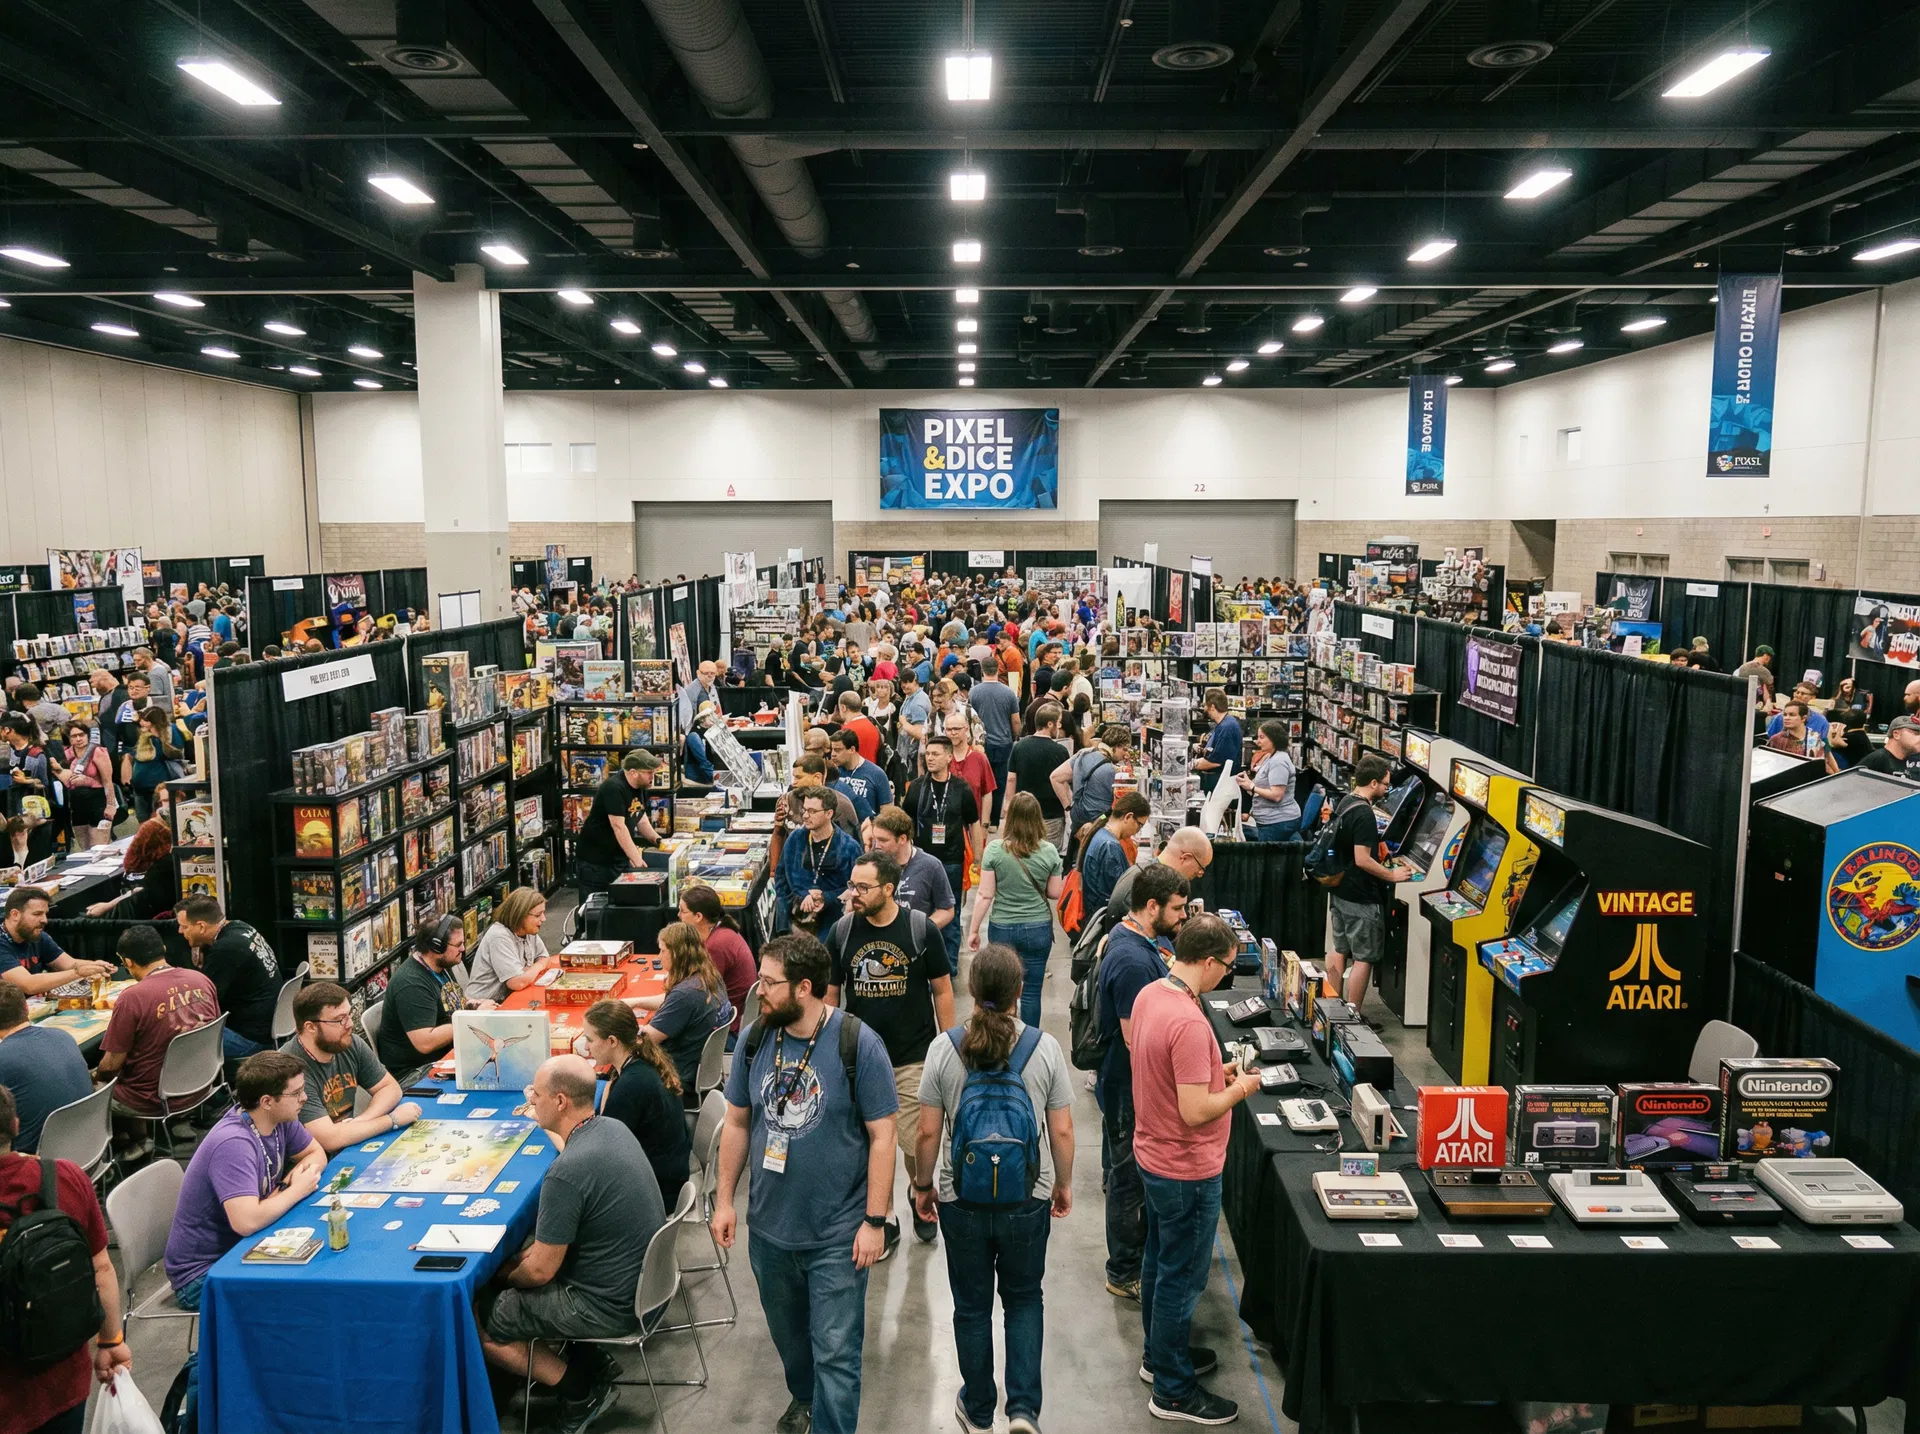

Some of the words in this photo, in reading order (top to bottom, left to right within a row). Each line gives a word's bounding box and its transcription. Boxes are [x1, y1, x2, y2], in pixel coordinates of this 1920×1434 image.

[924, 418, 1014, 444] PIXEL
[925, 473, 1014, 500] EXPO
[1194, 483, 1206, 493] 22
[1597, 892, 1693, 913] VINTAGE
[1606, 985, 1682, 1010] ATARI
[1748, 1079, 1824, 1093] Nintendo
[1642, 1099, 1706, 1110] Nintendo
[1434, 1142, 1494, 1164] ATARI
